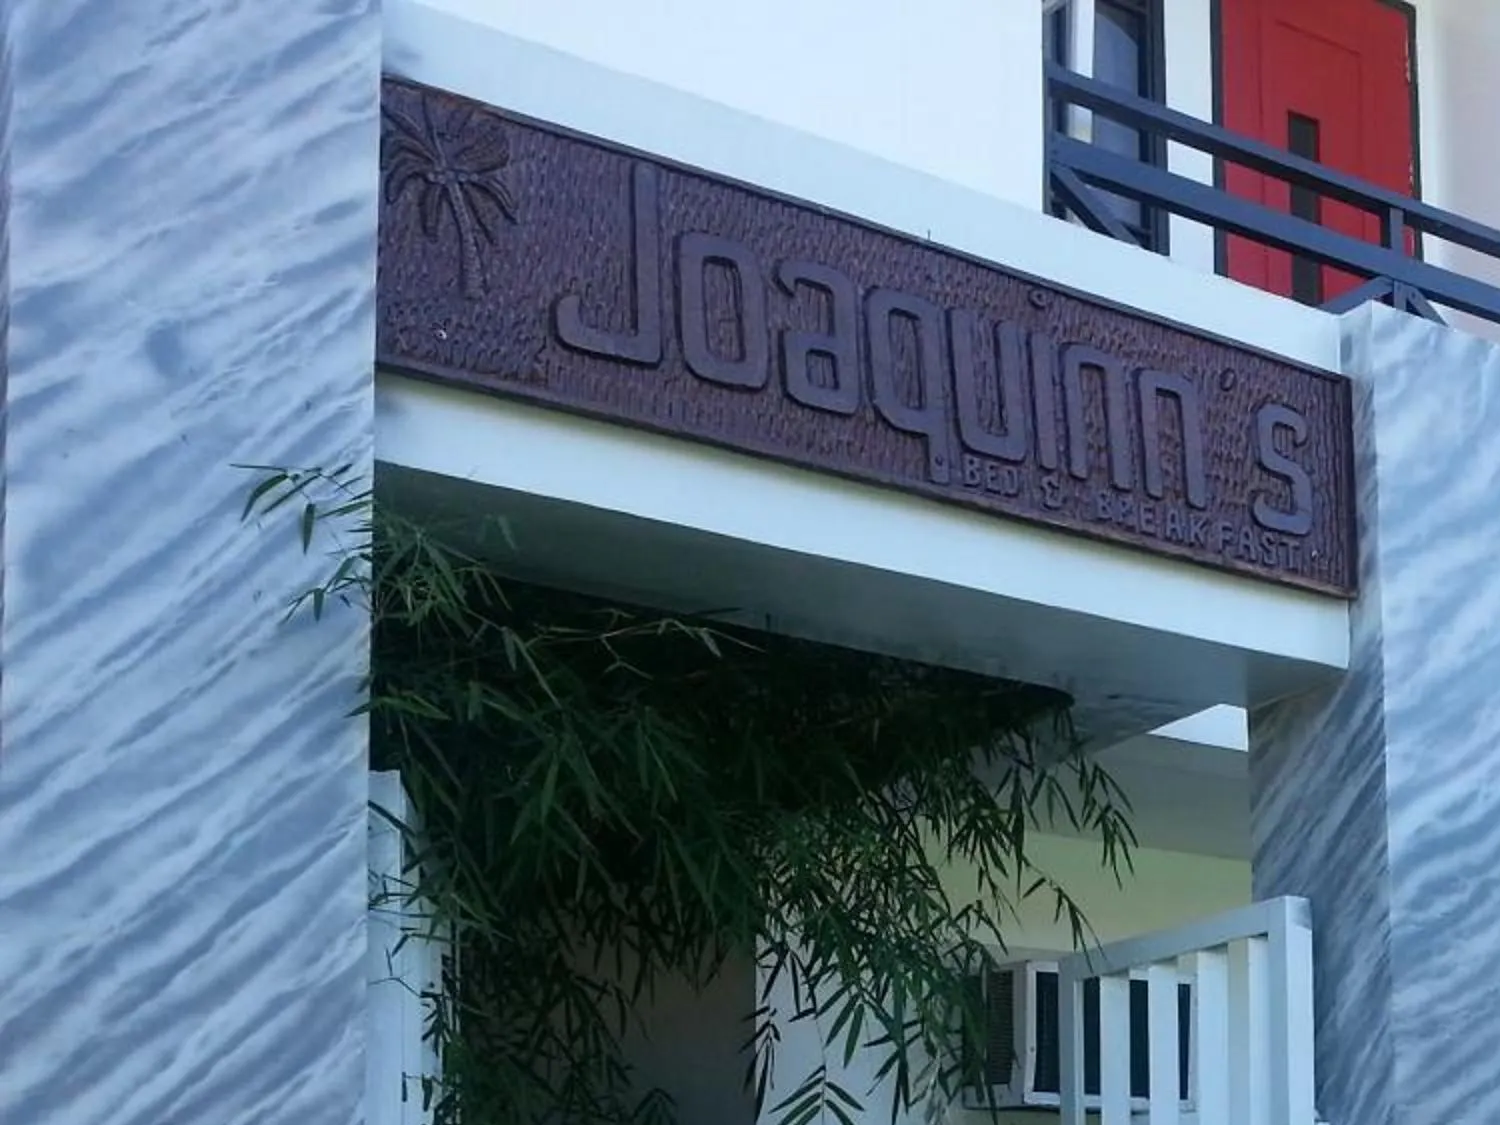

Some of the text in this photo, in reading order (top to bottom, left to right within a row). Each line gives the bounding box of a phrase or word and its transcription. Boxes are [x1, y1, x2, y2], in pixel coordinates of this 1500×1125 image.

[961, 455, 1305, 569] BED & BREAKFAST
